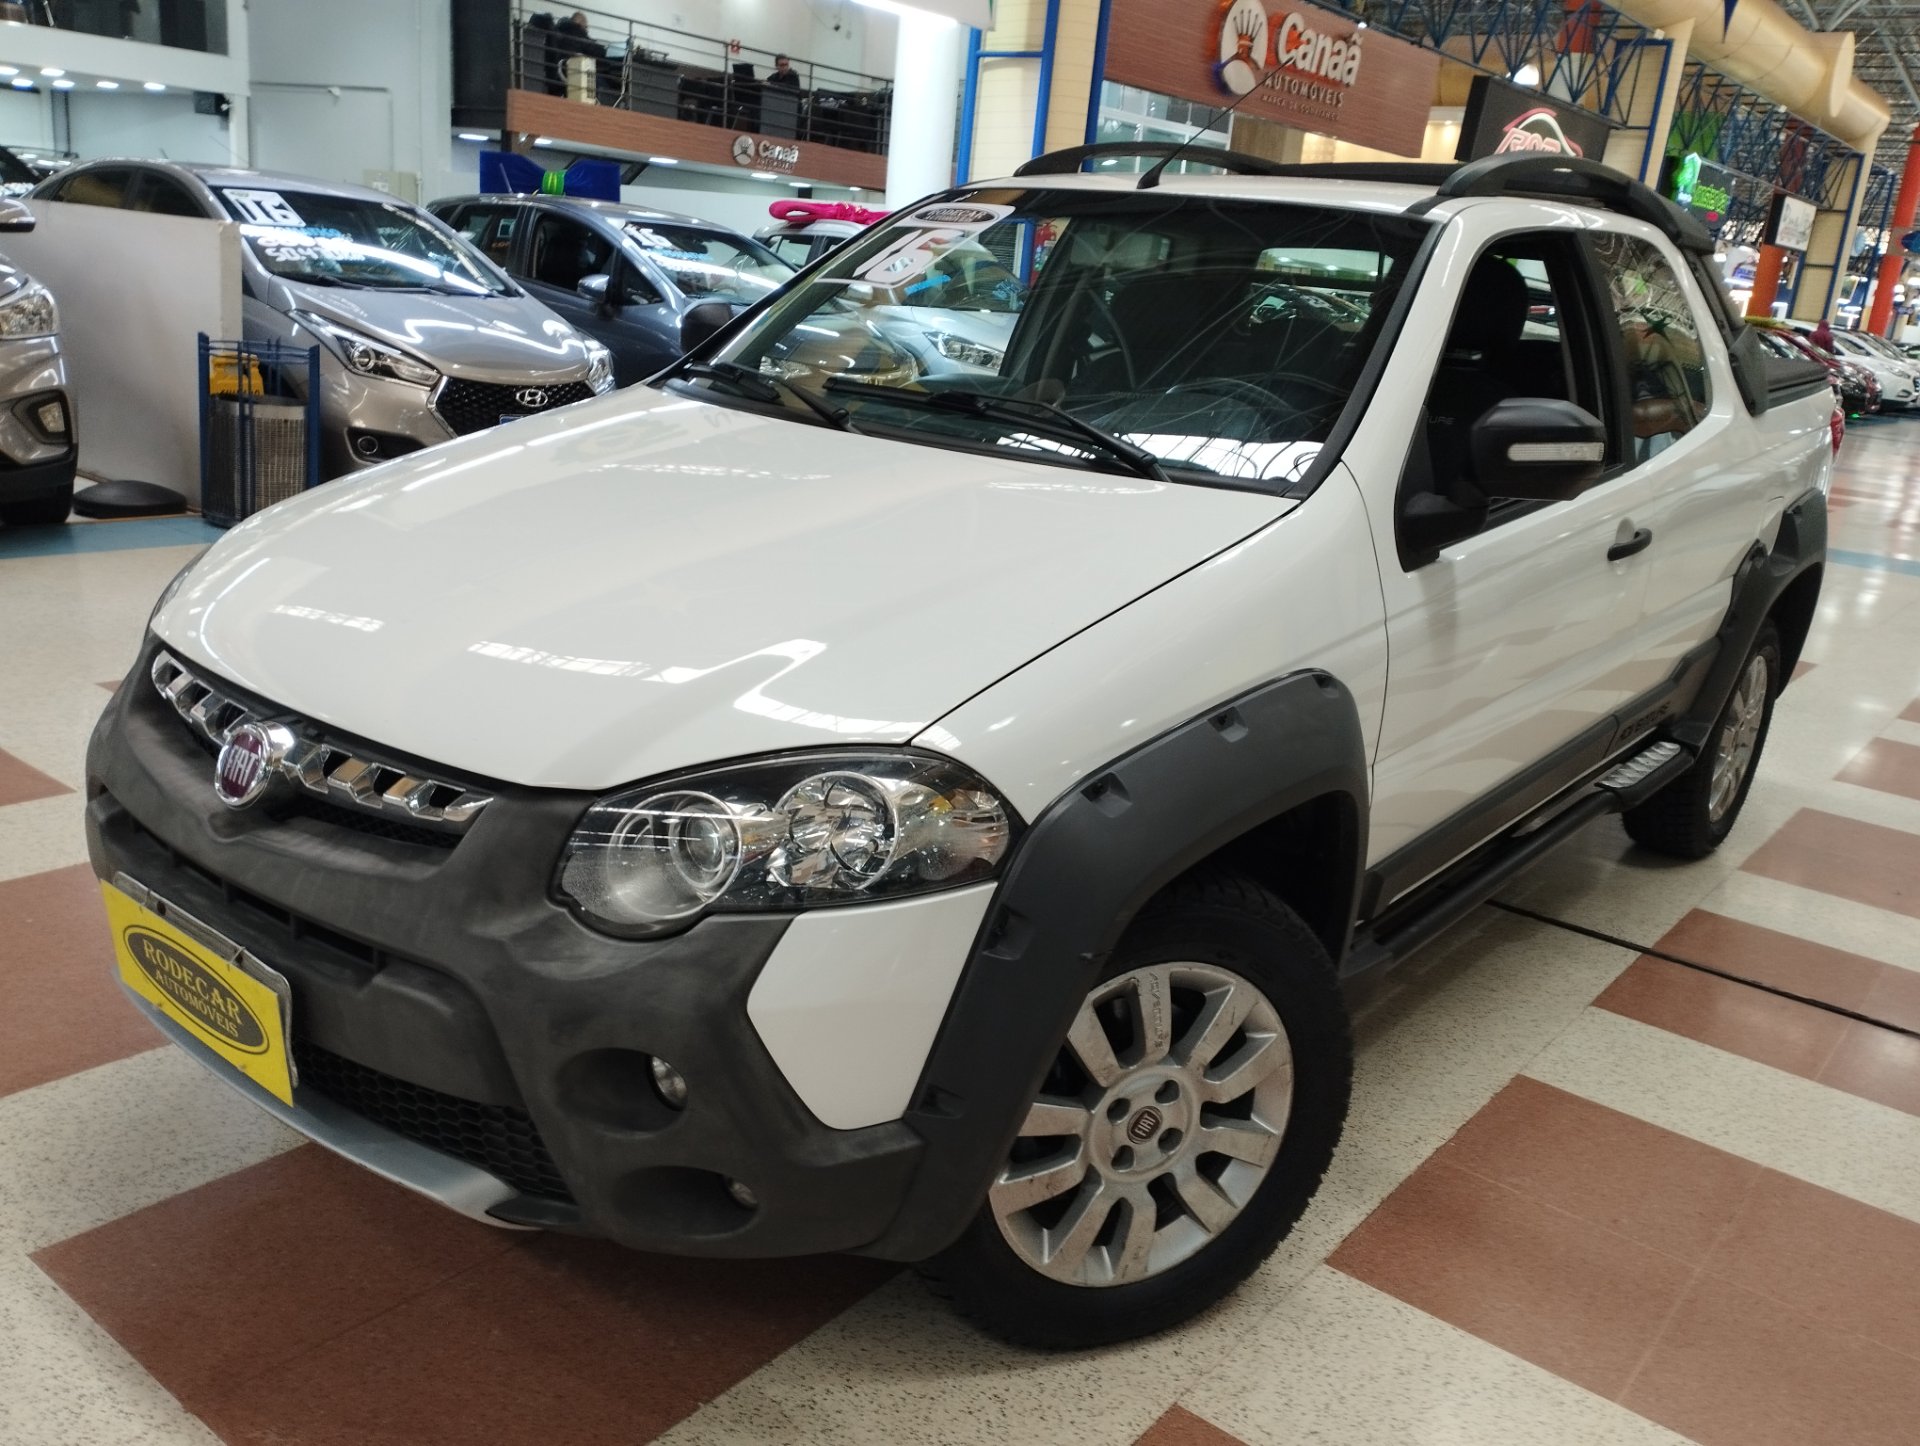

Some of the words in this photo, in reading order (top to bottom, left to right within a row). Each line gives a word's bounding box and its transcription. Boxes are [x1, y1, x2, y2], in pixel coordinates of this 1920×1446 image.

[1278, 12, 1363, 86] Canaã
[1264, 72, 1344, 108] AUTOMÓVEIS
[758, 140, 799, 163] Canaã
[224, 744, 259, 787] FIAT
[142, 938, 242, 1025] RODECAR
[155, 970, 239, 1038] AUTOMOVEIS
[1134, 1113, 1156, 1137] FIAT
